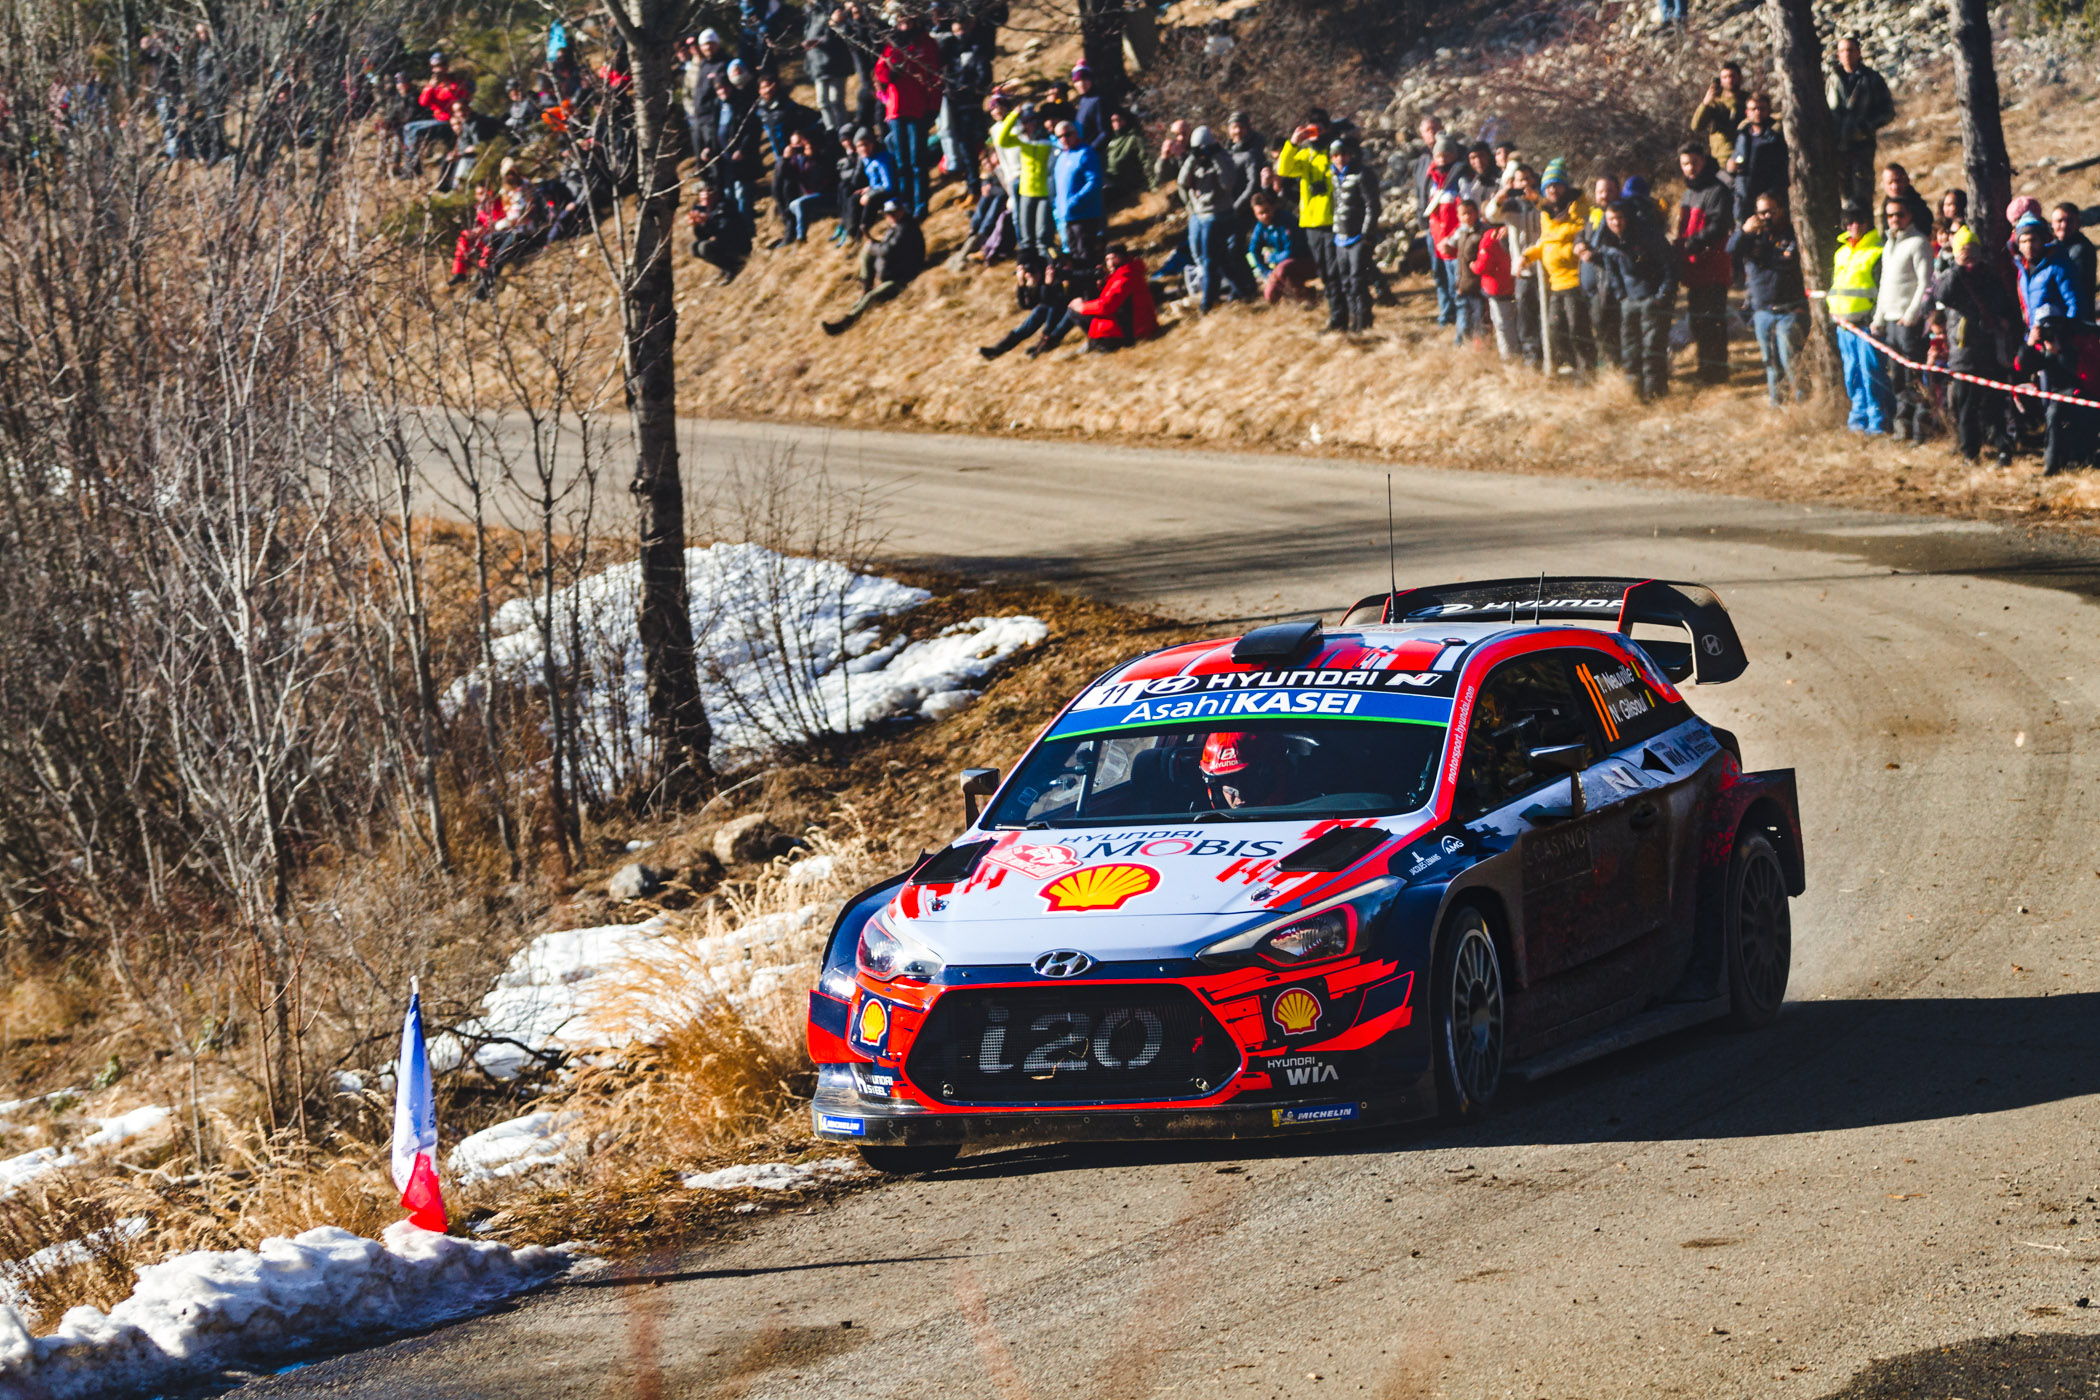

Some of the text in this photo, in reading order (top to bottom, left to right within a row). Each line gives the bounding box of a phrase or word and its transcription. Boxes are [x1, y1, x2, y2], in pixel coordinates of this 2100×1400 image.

[1482, 599, 1624, 610] HYUNDA
[1601, 664, 1635, 691] Neuville
[1098, 682, 1133, 706] 11
[1206, 670, 1379, 689] HYUNDAI
[1120, 691, 1363, 724] AsahiKASEI
[1576, 662, 1620, 742] 11
[1608, 692, 1649, 725] N. Gilsoul
[1447, 685, 1475, 785] motorsport.hyundai.com
[1058, 830, 1204, 845] HYUNDAI
[1083, 838, 1284, 858] MOBIS
[1445, 840, 1465, 855] AMG
[978, 1006, 1164, 1074] i20
[1267, 1055, 1316, 1069] HYUNDAI
[864, 1074, 894, 1086] HYUNDAI
[866, 1084, 888, 1096] STEEL
[1297, 1107, 1352, 1121] MICHELIN
[826, 1119, 861, 1131] MICHELIN
